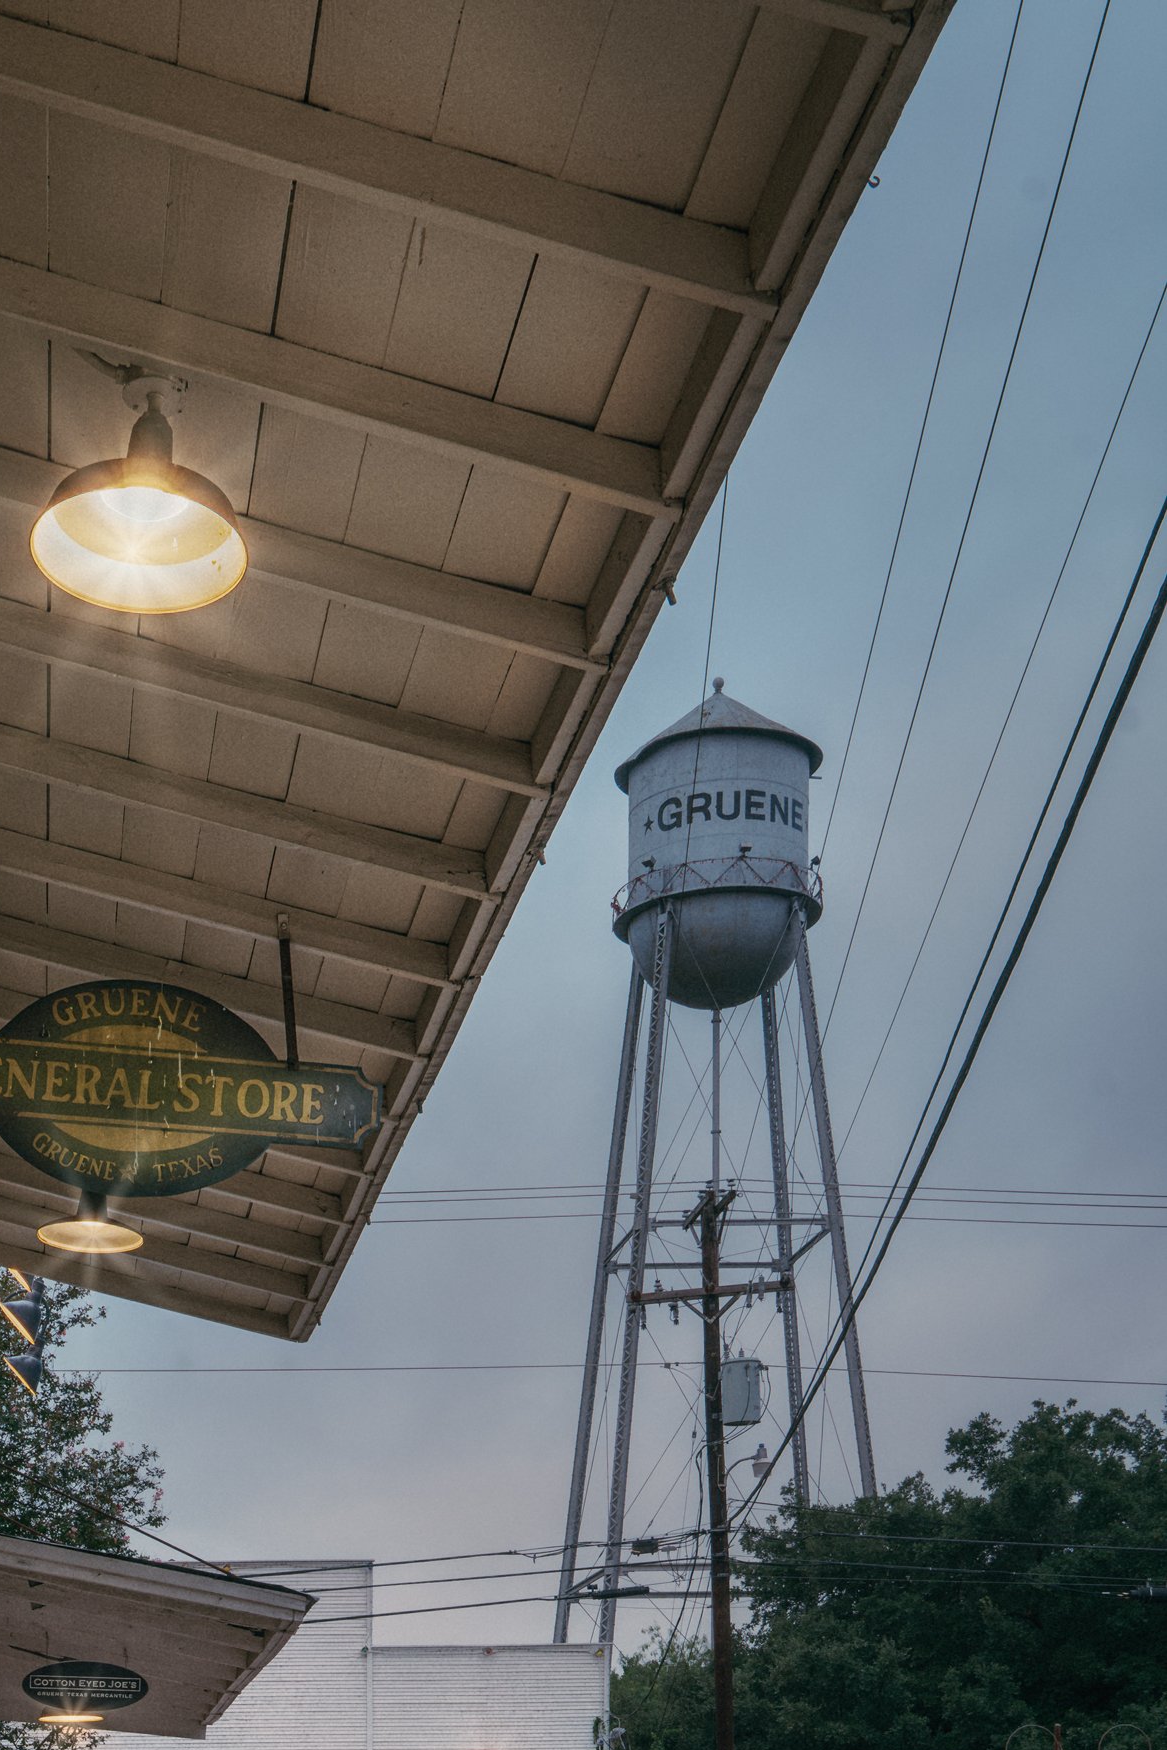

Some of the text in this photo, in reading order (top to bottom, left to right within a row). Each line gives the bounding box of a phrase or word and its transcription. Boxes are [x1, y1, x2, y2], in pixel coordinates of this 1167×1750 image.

[657, 789, 804, 833] GRUENE
[51, 987, 208, 1033] GRUENE
[172, 1071, 328, 1125] STORE
[31, 1131, 225, 1184] GRUENE TEXAS
[33, 1677, 138, 1690] COTTON EYED JOE'S
[90, 1692, 134, 1700] MERCANTILE
